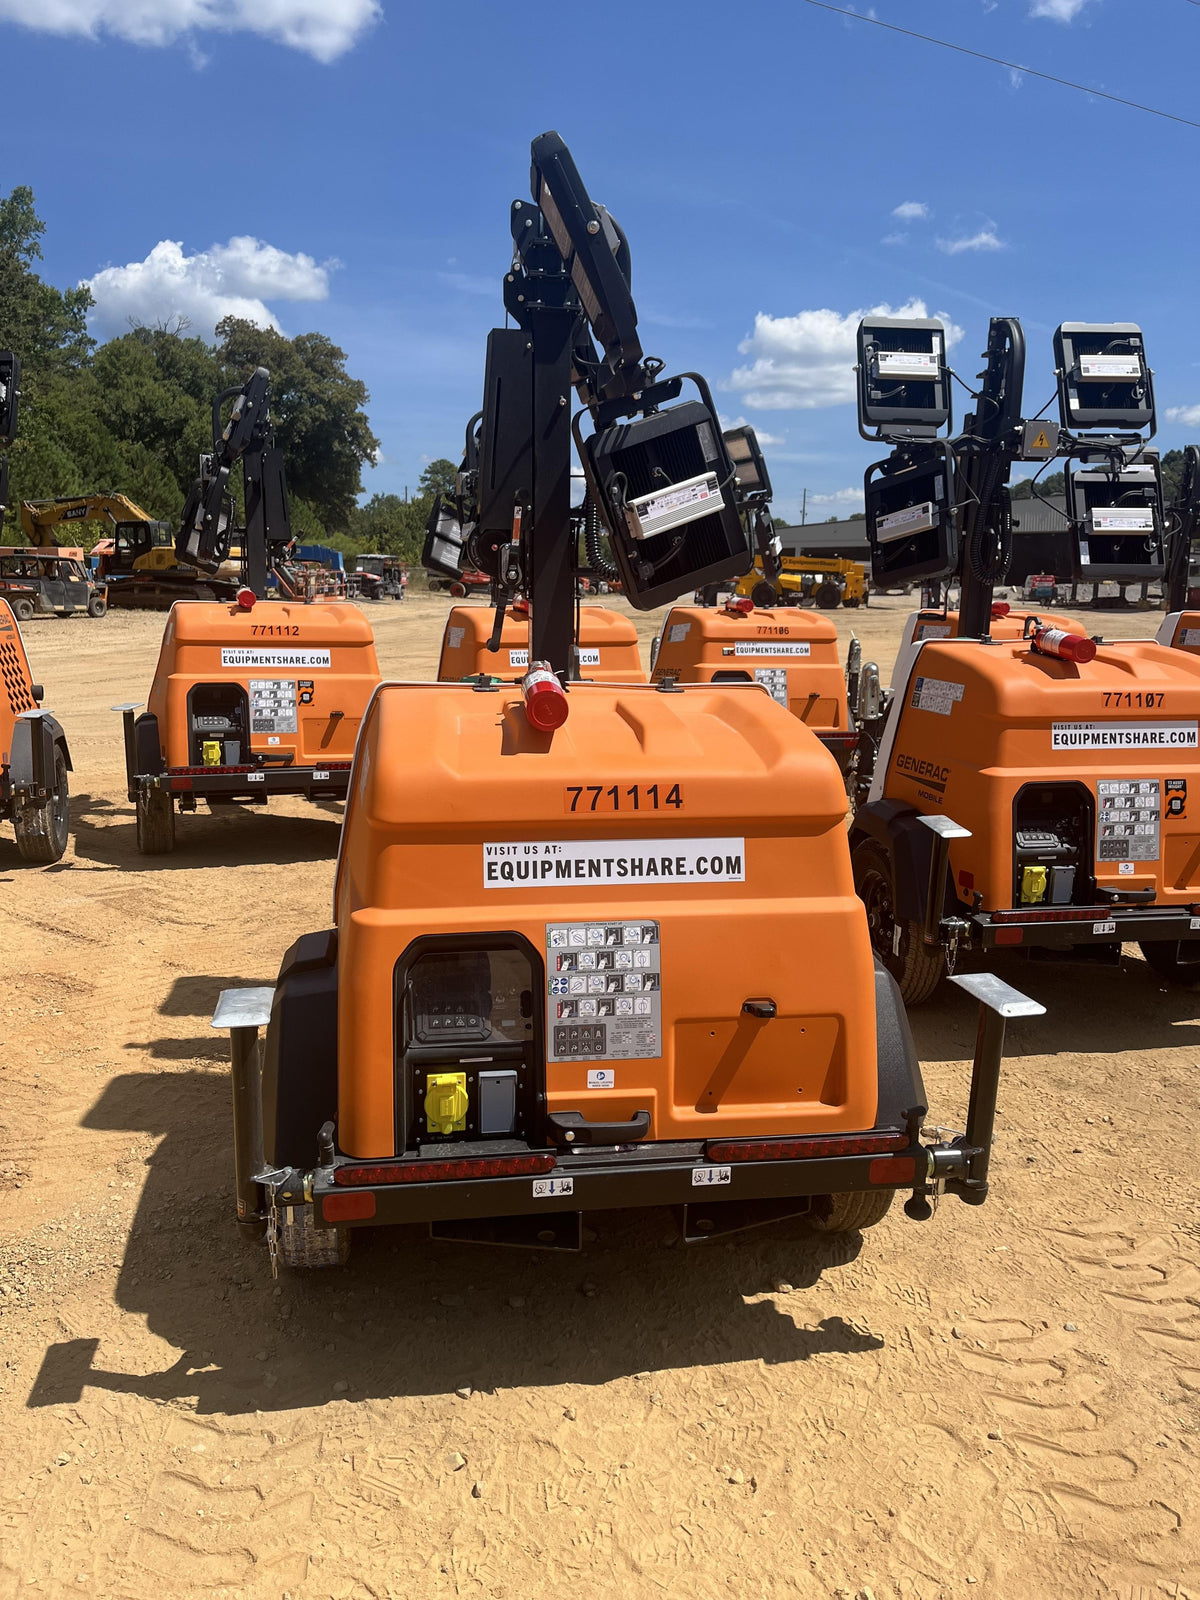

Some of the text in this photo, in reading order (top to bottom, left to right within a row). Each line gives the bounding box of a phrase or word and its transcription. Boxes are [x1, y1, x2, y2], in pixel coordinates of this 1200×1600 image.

[251, 625, 300, 636] 771112
[736, 646, 810, 655] EQUIPMENTSHARE.COM
[223, 656, 330, 665] EQUIPMENTSHARE.COM
[1102, 692, 1164, 708] 771107
[1054, 732, 1196, 746] EQUIPMENTSHARE.COM
[896, 754, 950, 782] GENERAC
[566, 784, 683, 812] 771114
[918, 789, 943, 804] MOBILE
[486, 845, 562, 856] VISIT US AT:
[487, 856, 742, 882] EQUIPMENTSHARE.COM
